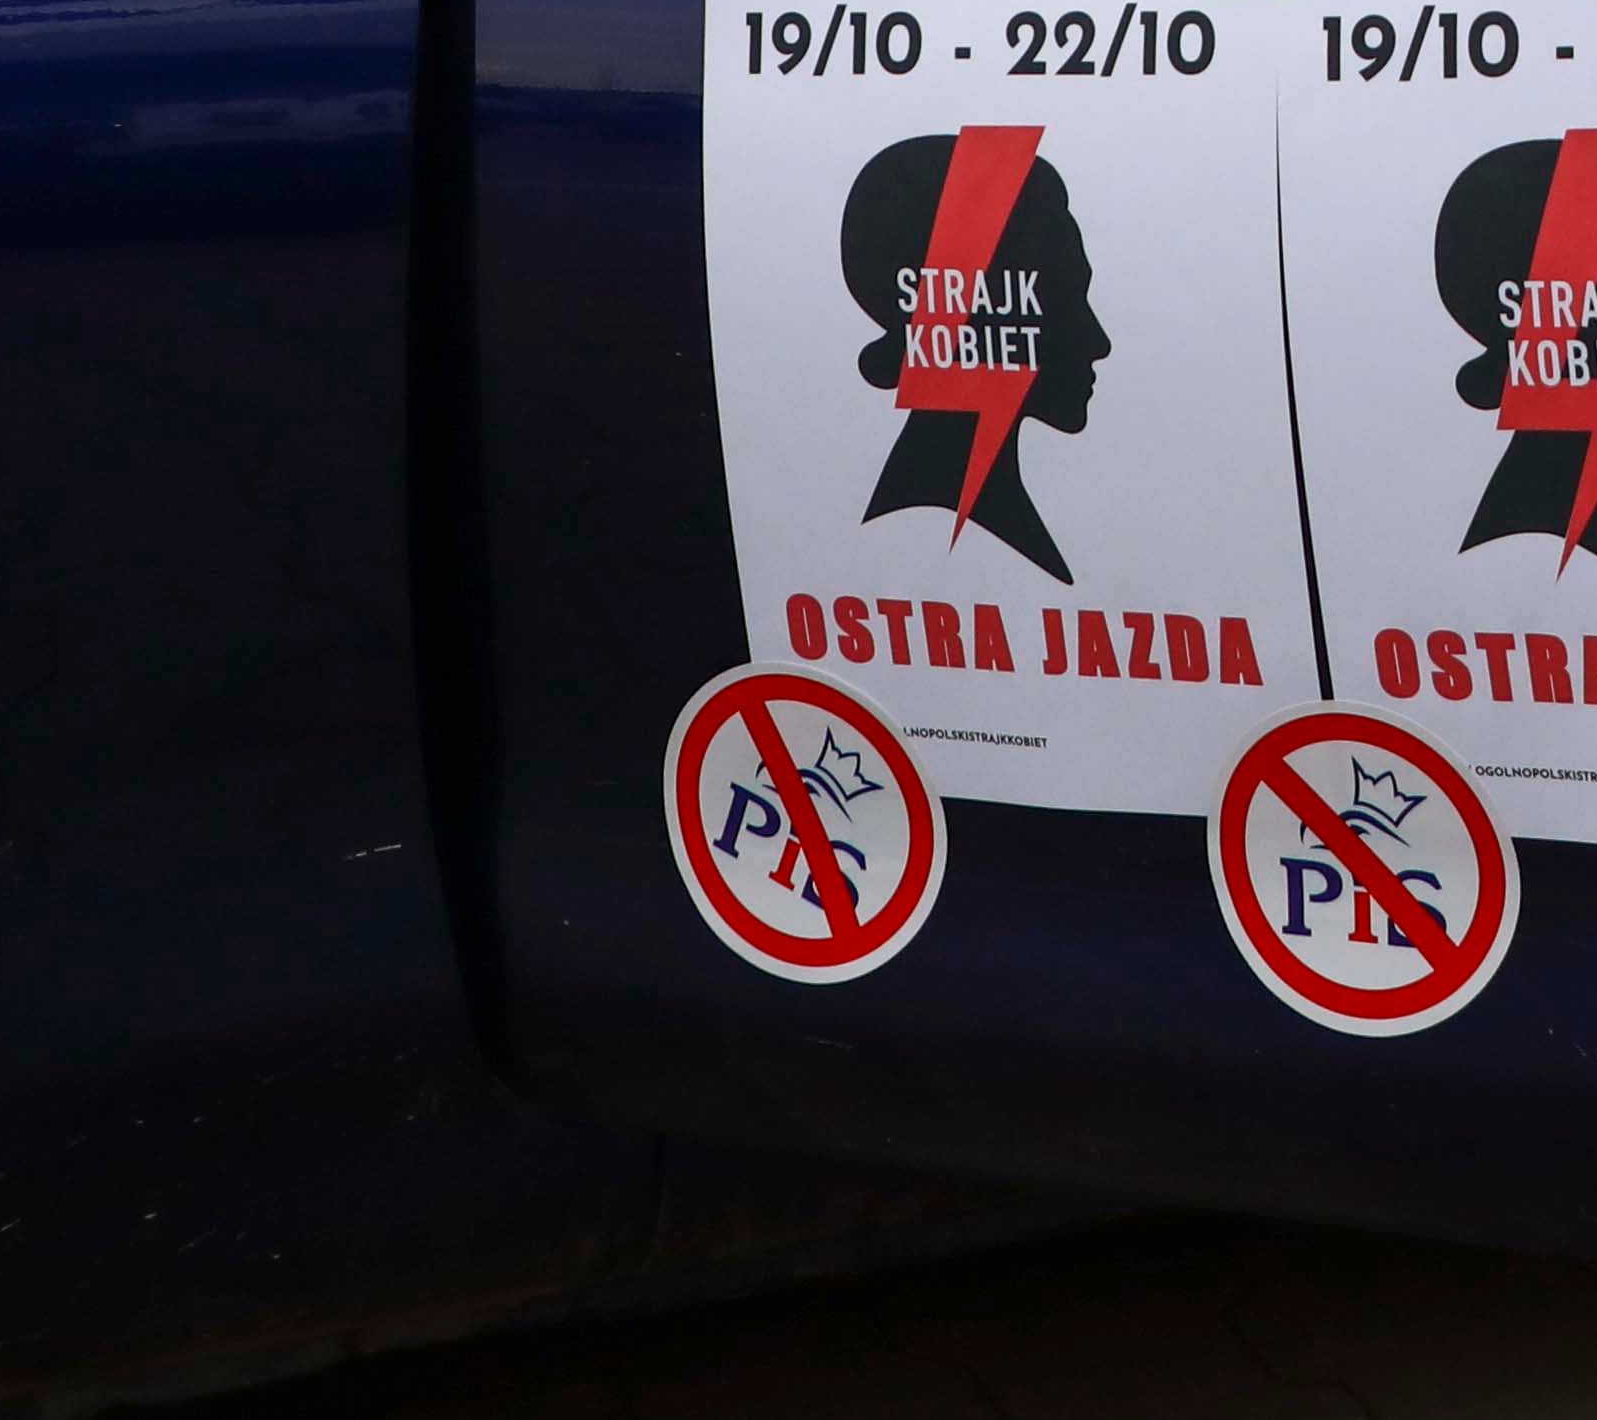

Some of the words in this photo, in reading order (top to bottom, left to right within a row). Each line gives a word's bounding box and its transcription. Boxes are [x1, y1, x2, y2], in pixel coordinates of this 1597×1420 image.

[745, 4, 922, 77] 19/10
[954, 46, 971, 60] -
[1006, 2, 1216, 77] 22/10
[1322, 5, 1520, 82] 19/10
[1555, 46, 1575, 60] -
[897, 268, 1042, 316] STRAJK
[905, 324, 1041, 372] KOBIET
[786, 594, 1014, 673] OSTRA
[1042, 609, 1264, 687] JAZDA
